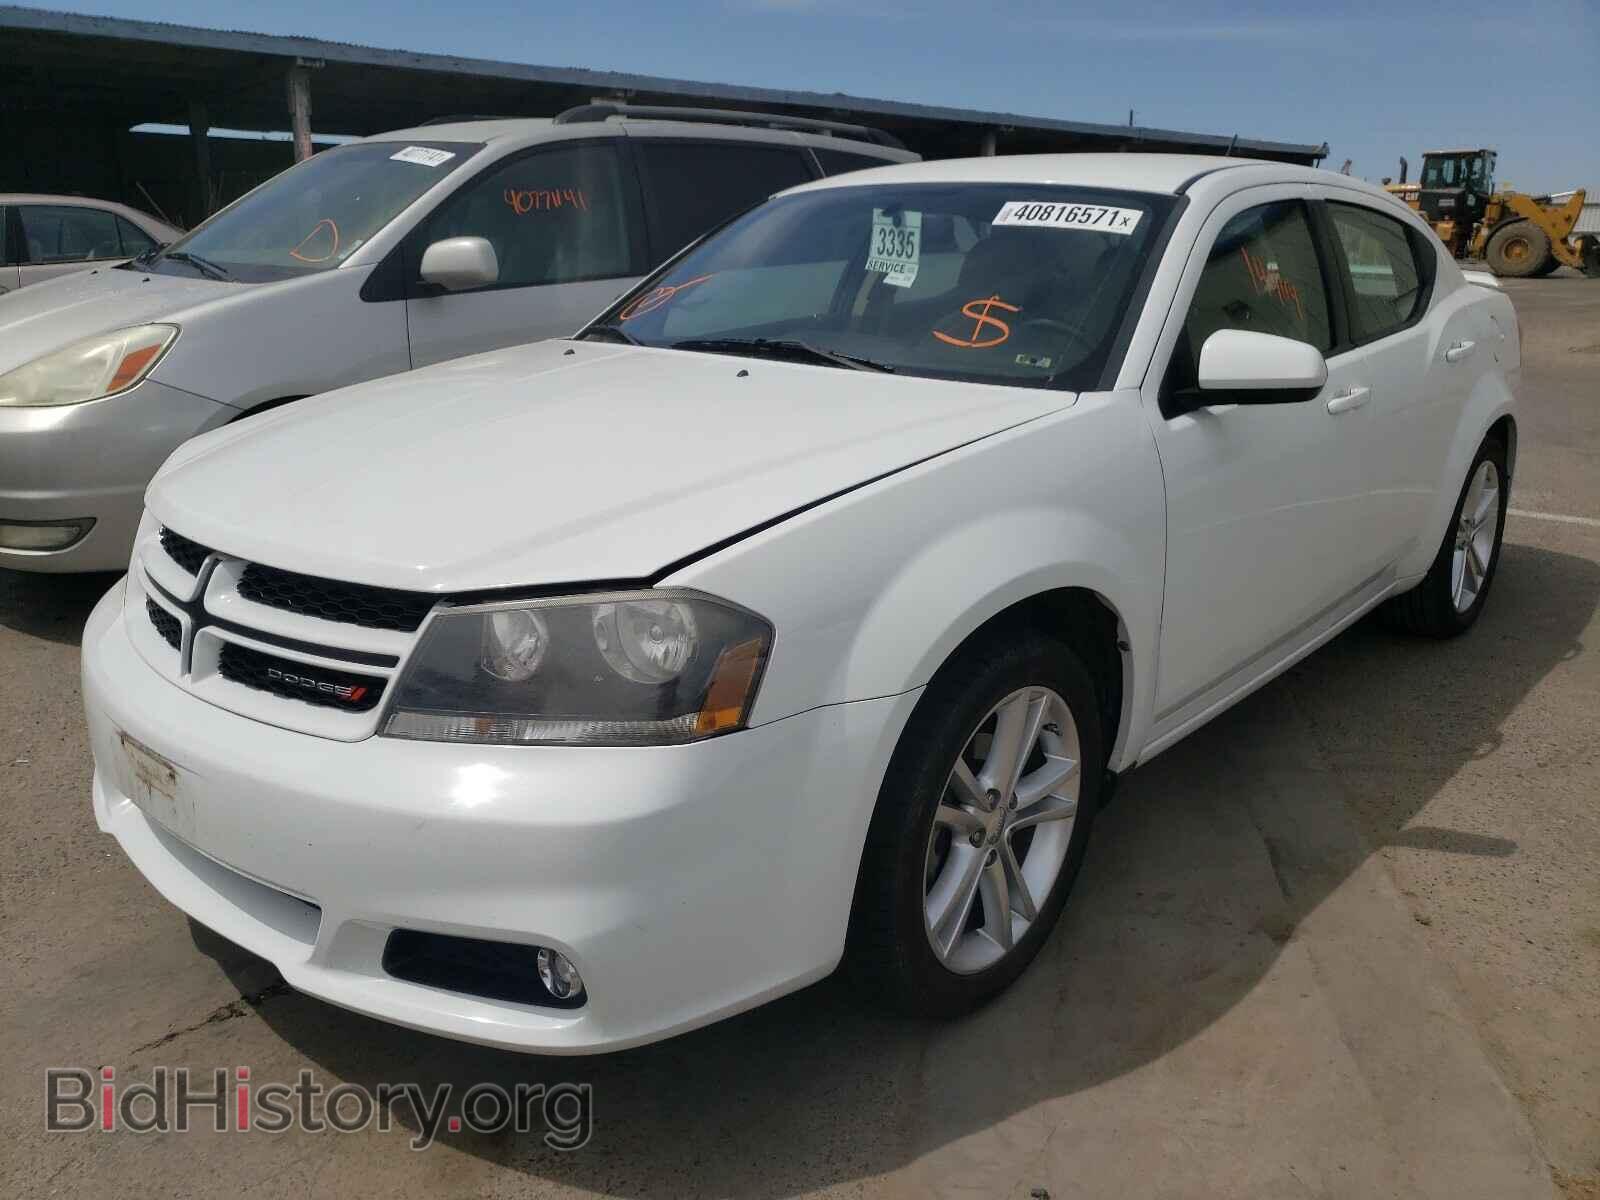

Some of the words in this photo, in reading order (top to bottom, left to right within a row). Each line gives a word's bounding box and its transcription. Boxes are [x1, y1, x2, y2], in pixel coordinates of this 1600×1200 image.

[877, 227, 915, 259] 3335
[867, 259, 905, 274] SERVICE
[267, 668, 352, 697] DODGE
